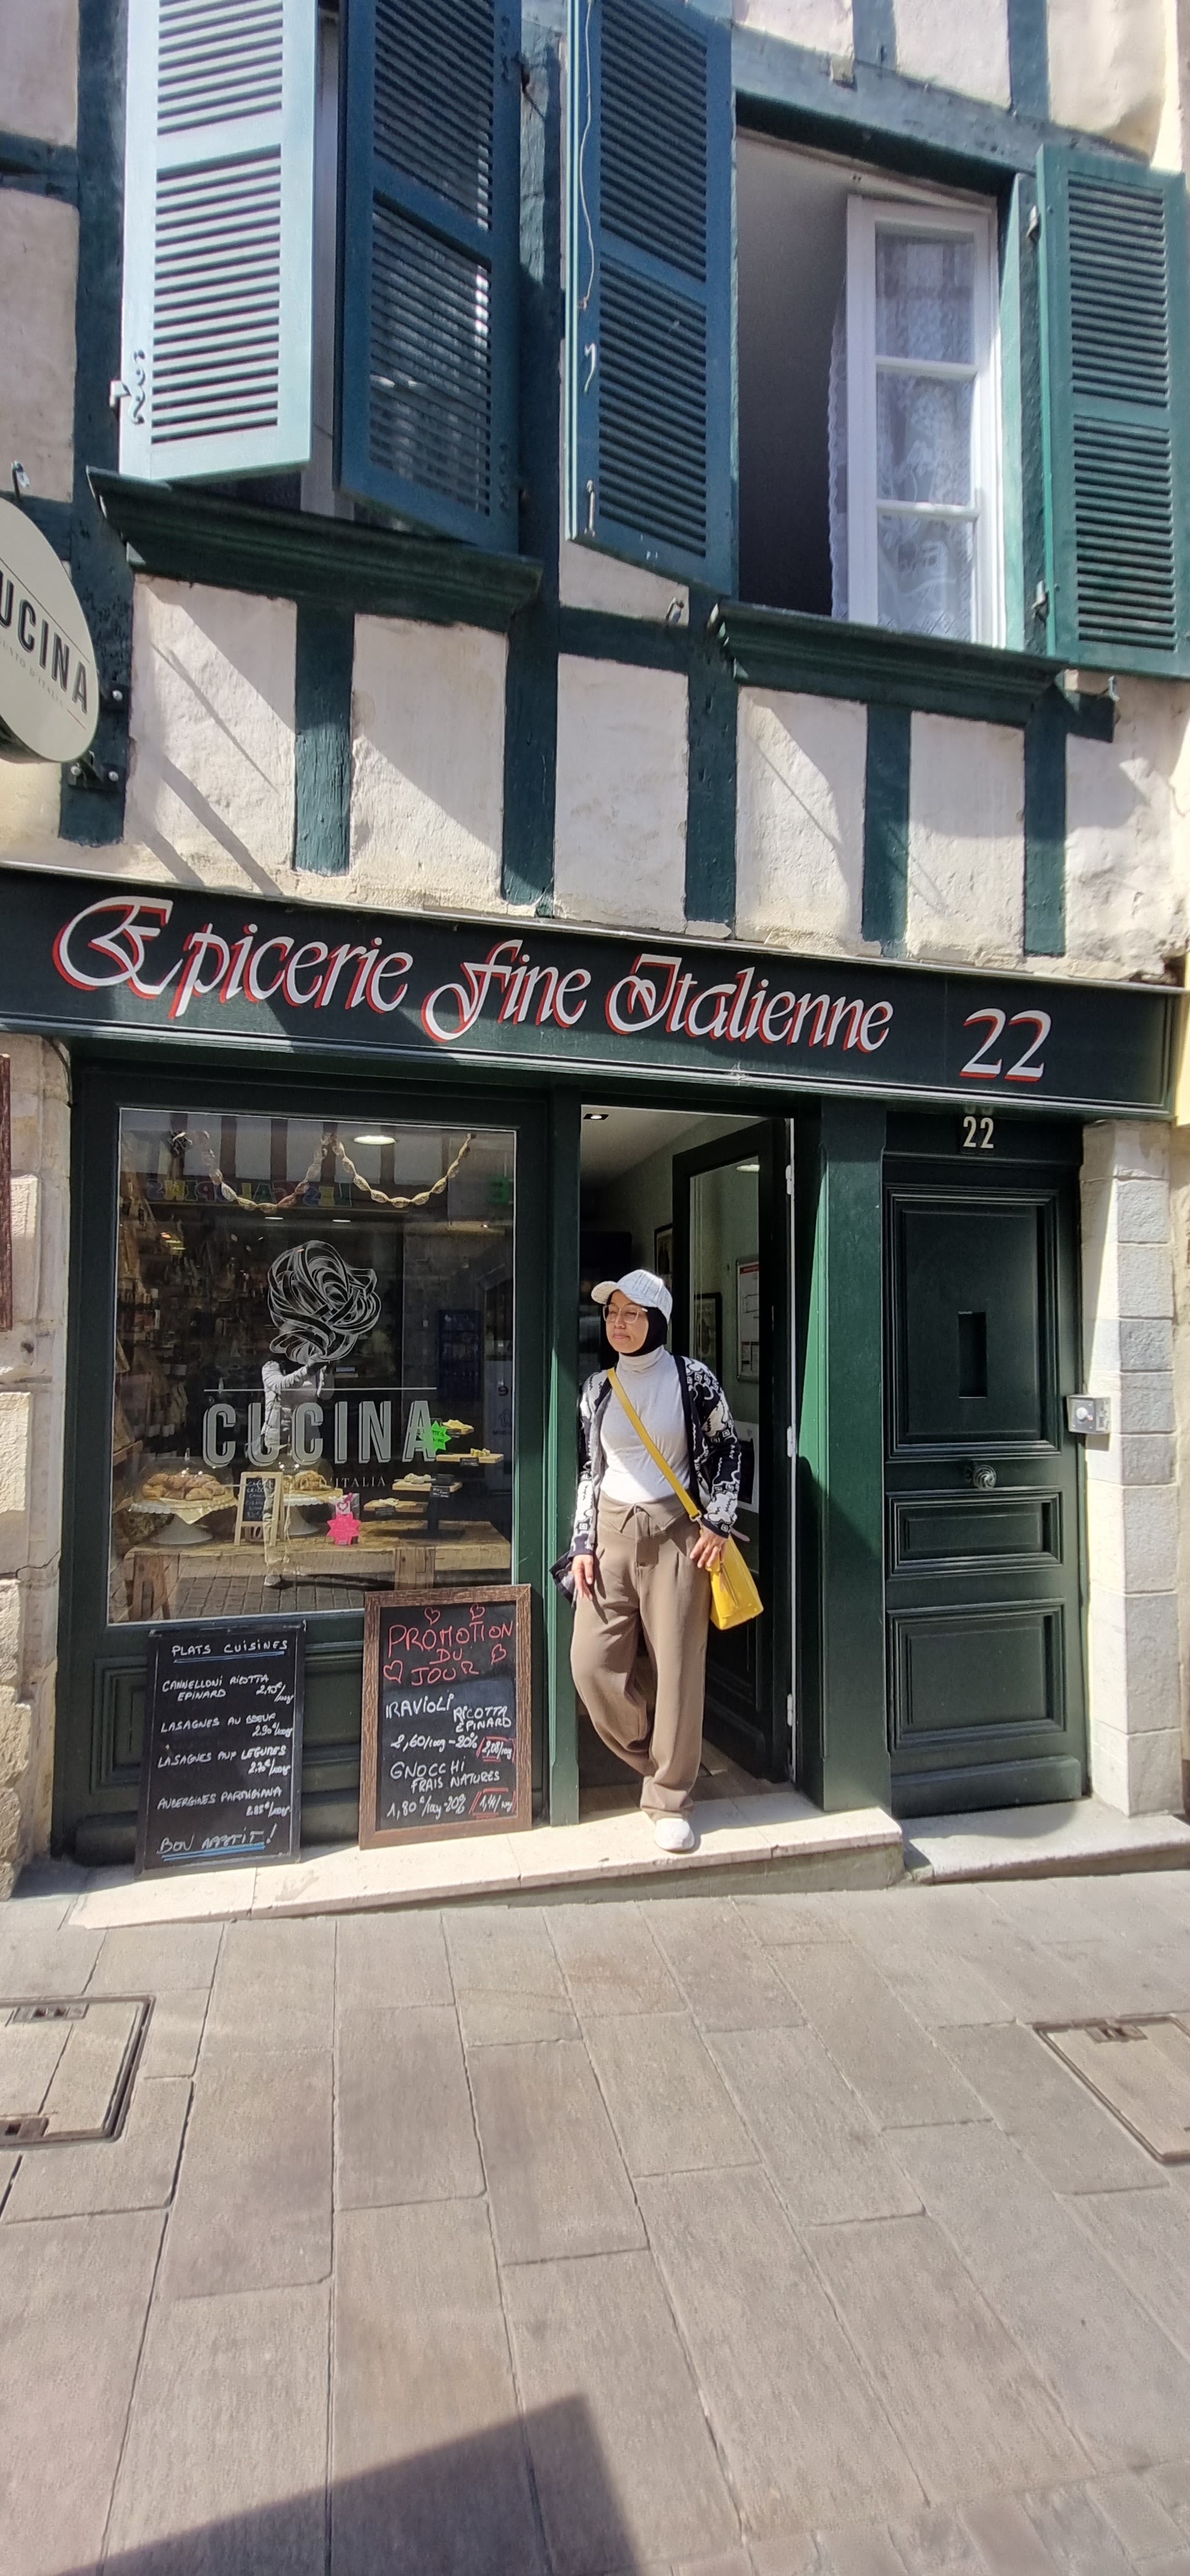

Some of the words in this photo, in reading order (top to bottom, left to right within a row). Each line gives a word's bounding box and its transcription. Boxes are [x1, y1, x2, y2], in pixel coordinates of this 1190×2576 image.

[0, 638, 26, 668] USTO
[51, 895, 413, 1019] Epicerie
[605, 952, 894, 1054] Italienne
[959, 1007, 1053, 1083] 22
[963, 1115, 995, 1150] 22
[202, 1399, 437, 1468] CUCINA
[172, 1644, 212, 1657] PLATS
[388, 1620, 514, 1658] PROMOTION
[429, 1647, 464, 1664] DU
[411, 1660, 479, 1686] JOUR
[177, 1689, 226, 1701] EPINARD
[160, 1717, 220, 1733] LASAGNES
[227, 1717, 241, 1726] AU
[157, 1752, 212, 1768] LASAGNES
[410, 1776, 444, 1794] FRAIS
[450, 1770, 500, 1788] NATURES
[156, 1835, 195, 1854] BON
